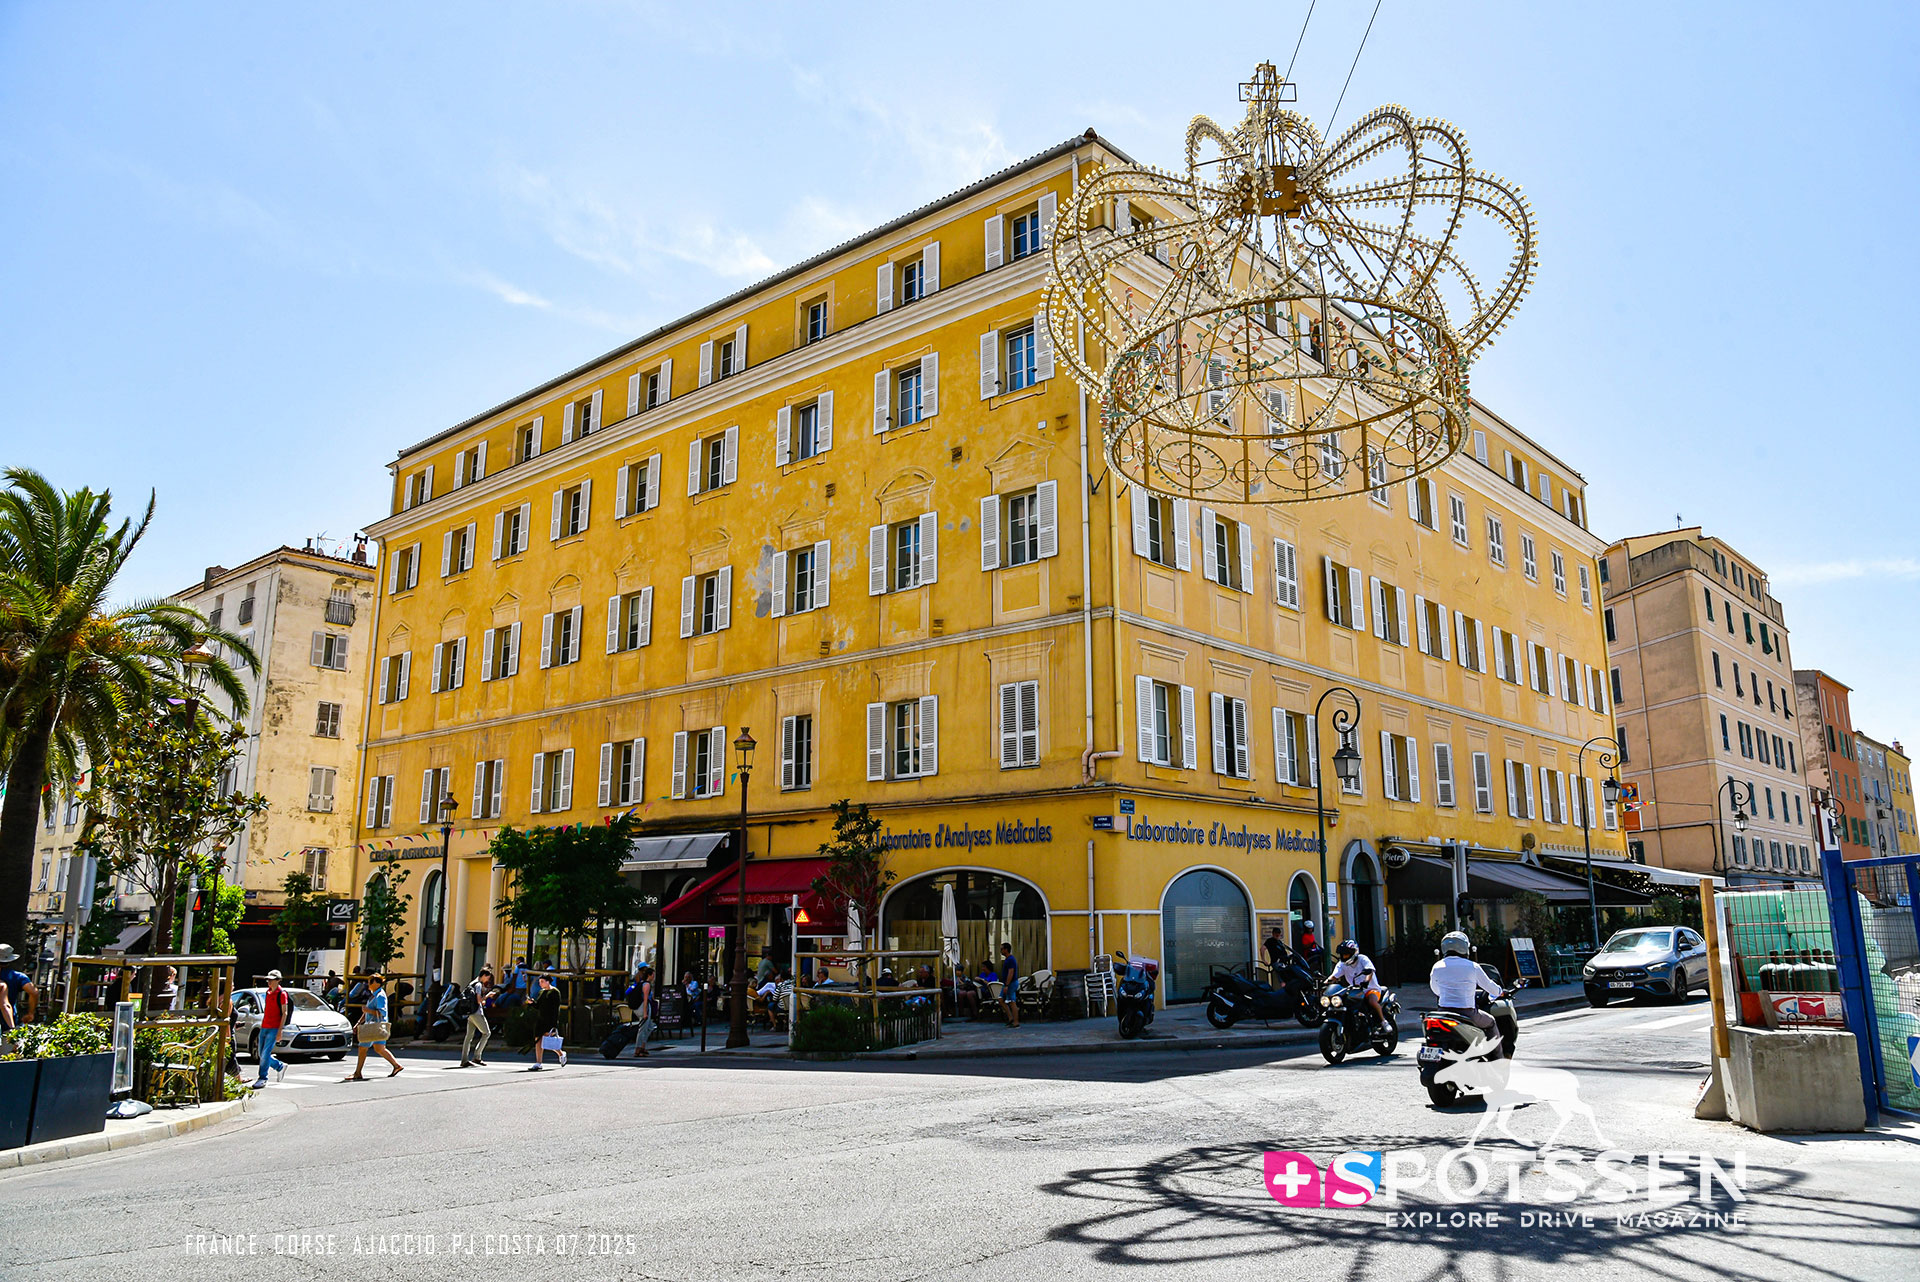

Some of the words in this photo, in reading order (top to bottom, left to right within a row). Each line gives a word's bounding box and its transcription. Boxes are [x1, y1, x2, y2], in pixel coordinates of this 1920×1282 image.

[876, 827, 932, 850] Laboratoire
[995, 817, 1052, 845] Médicales
[1127, 815, 1205, 845] Laboratoire
[1208, 821, 1272, 854] d'Analyses
[1384, 851, 1405, 862] Pietra
